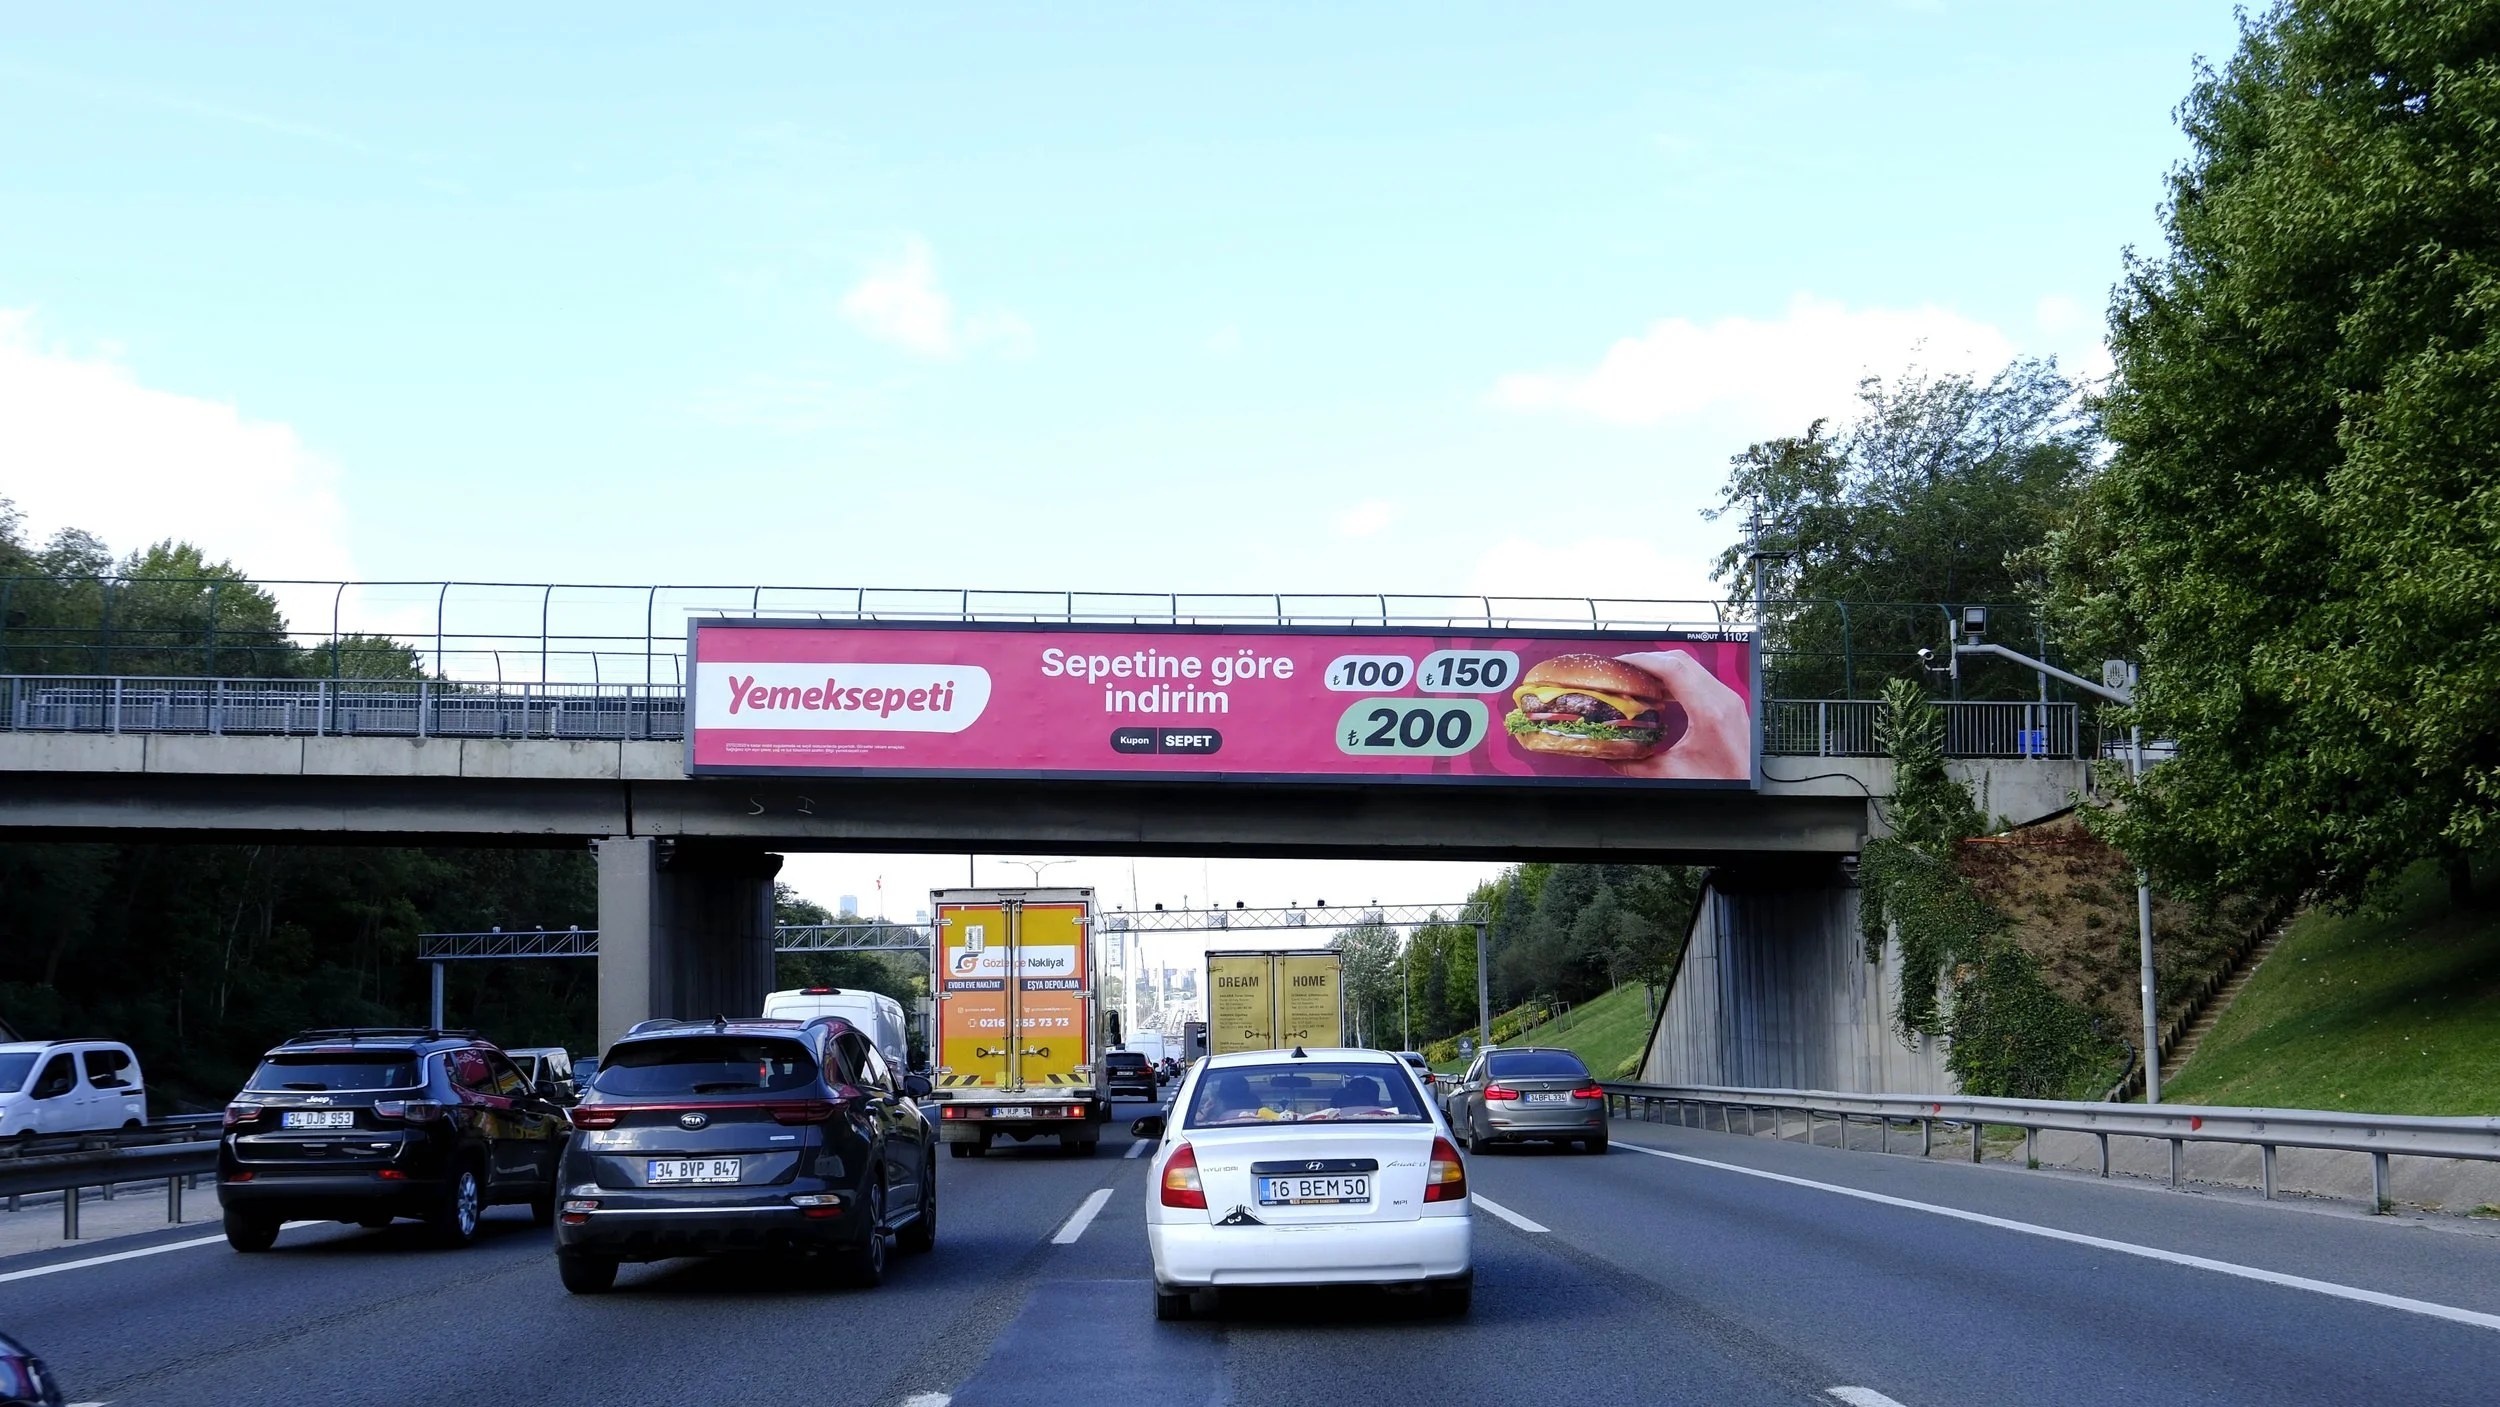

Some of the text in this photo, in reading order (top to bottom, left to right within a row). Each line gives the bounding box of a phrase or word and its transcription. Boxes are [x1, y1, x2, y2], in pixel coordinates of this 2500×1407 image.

[1723, 632, 1749, 642] 1102
[1041, 648, 1294, 685] Sepetine göre
[728, 675, 954, 719] Yemeksepeti
[1105, 683, 1233, 714] indirim
[1120, 735, 1213, 747] Kupon SEPET
[1028, 958, 1065, 969] Nakliyat
[948, 981, 965, 989] EVDEN
[966, 981, 976, 989] EVE
[1027, 980, 1079, 990] EŞYA DEPOLAMA
[1218, 976, 1259, 988] DREAM
[1293, 975, 1326, 987] HOME
[979, 1018, 1005, 1028] 0216
[1038, 1018, 1053, 1027] 73
[1055, 1017, 1069, 1027] 73
[306, 1095, 330, 1104] Jeep
[288, 1112, 351, 1125] 34 DJB 953
[657, 1160, 739, 1177] 34 BVP 847
[1271, 1178, 1366, 1198] 16 BEM 50
